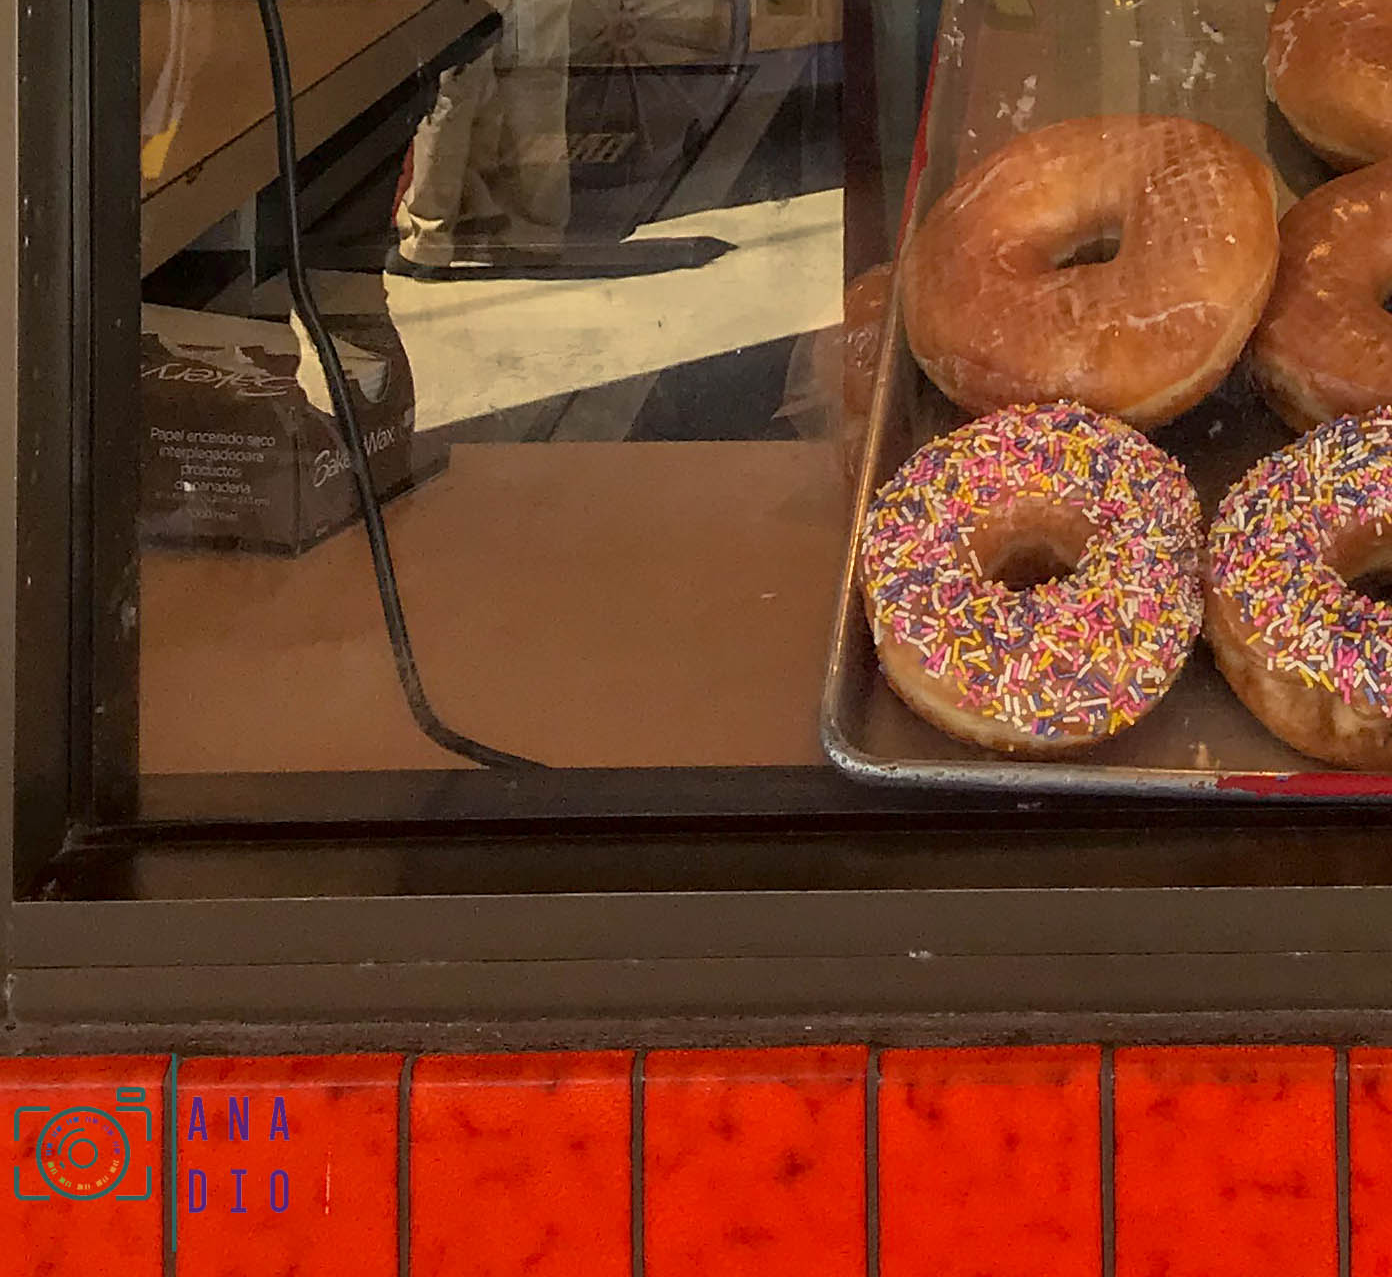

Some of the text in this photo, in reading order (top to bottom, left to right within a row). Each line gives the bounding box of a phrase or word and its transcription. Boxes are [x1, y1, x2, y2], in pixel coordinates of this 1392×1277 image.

[150, 427, 185, 445] Papel
[246, 433, 276, 448] seco
[363, 426, 396, 456] Wax
